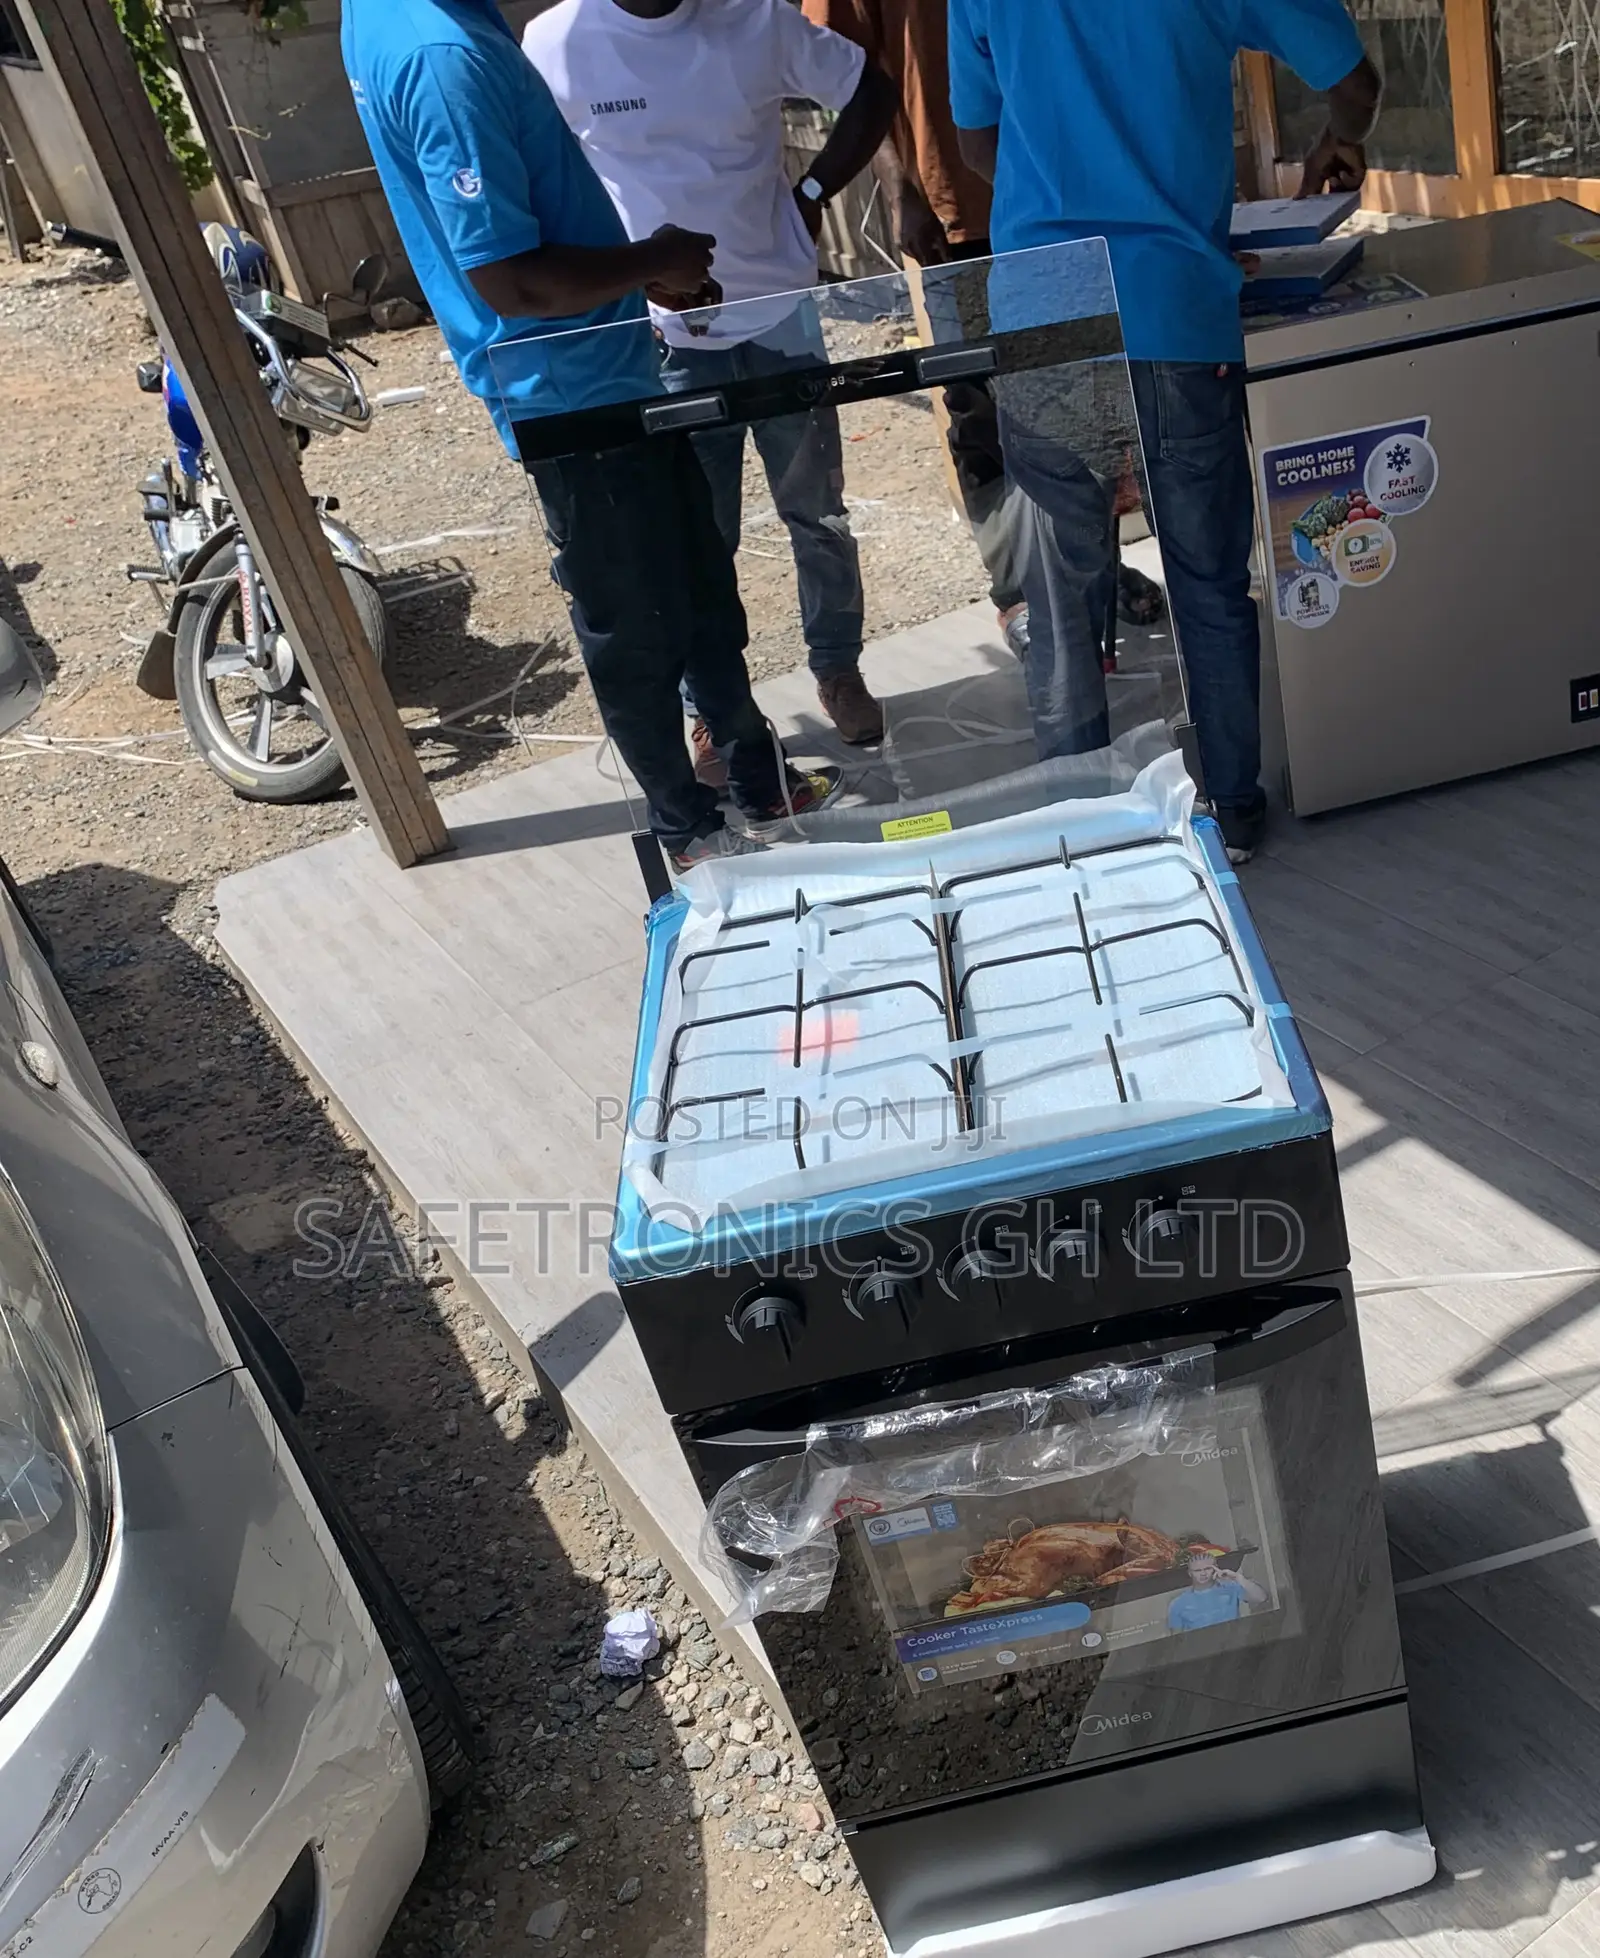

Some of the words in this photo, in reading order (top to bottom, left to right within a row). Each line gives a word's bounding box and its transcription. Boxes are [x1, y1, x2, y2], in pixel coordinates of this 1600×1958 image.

[590, 98, 647, 115] SAMSUNG
[1275, 455, 1315, 472] BRING
[1318, 446, 1355, 463] HOME
[1277, 459, 1356, 486] COOLNESS
[1388, 475, 1416, 489] FAST
[1380, 484, 1426, 501] COOLING
[1349, 555, 1380, 568] ENERGY
[1350, 562, 1381, 574] SAVING
[897, 816, 934, 829] ATTENTION
[1180, 1446, 1239, 1467] Midea
[907, 1631, 957, 1648] Cooker
[960, 1613, 1044, 1636] TasteXpress
[1080, 1711, 1153, 1736] Midea
